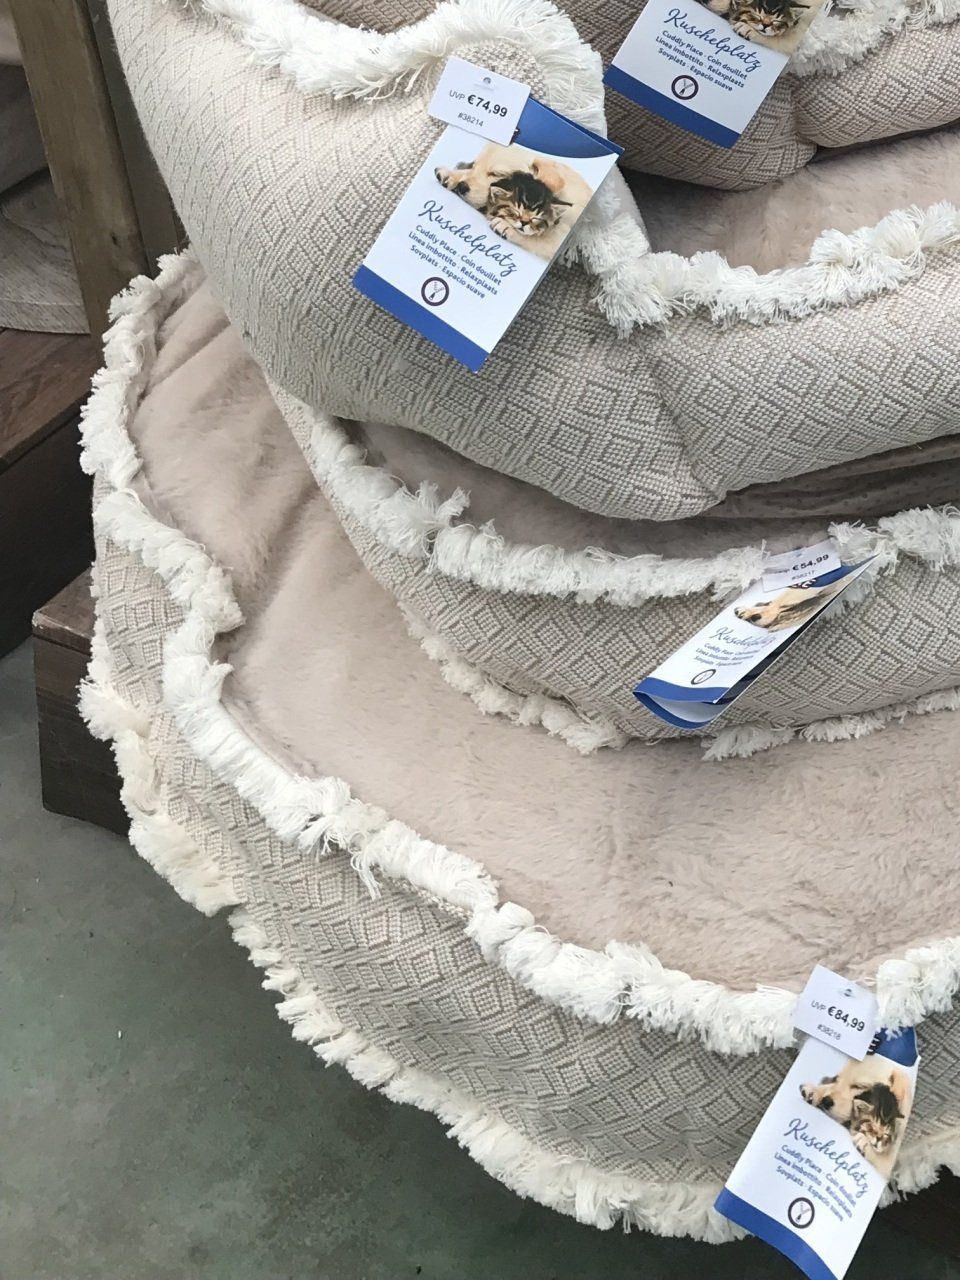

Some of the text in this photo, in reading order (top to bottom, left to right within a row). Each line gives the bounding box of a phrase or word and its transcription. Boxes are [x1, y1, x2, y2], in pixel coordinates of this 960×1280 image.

[655, 36, 745, 88] Linea imbottito Relaxplaats
[662, 30, 748, 81] Cuddly Place Coin douillet
[663, 8, 762, 73] Kuschelplatz
[658, 47, 733, 92] Sovplats Espacio suave
[449, 89, 508, 117] UVP €74,99
[457, 112, 484, 127] #38214
[408, 231, 498, 295] Linea imbottito Relaxplaats
[416, 224, 502, 286] Cuddly Place Coin douillet
[418, 199, 517, 277] Kuschelplatz
[410, 244, 486, 299] Sovplats Espacio suave
[792, 554, 829, 571] €54,99
[810, 1000, 865, 1032] UVP €84,99
[783, 1118, 869, 1199] Kuschelplatz
